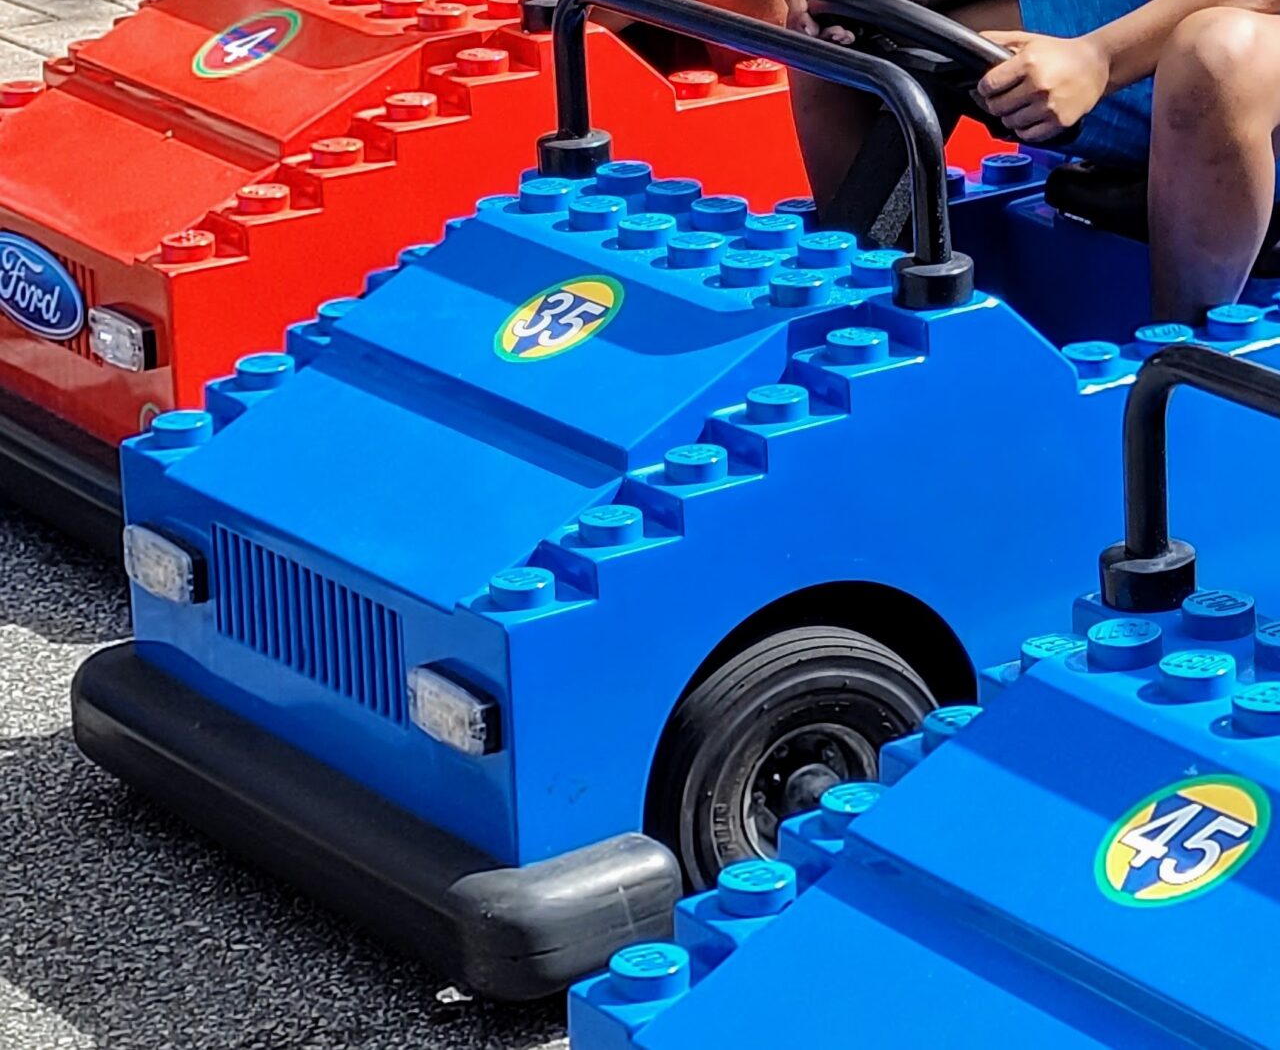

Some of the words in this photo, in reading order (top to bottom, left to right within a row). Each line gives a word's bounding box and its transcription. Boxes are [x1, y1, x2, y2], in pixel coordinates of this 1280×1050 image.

[223, 27, 277, 63] 4
[0, 246, 61, 324] Ford
[512, 291, 606, 346] 35
[1119, 803, 1250, 886] 45
